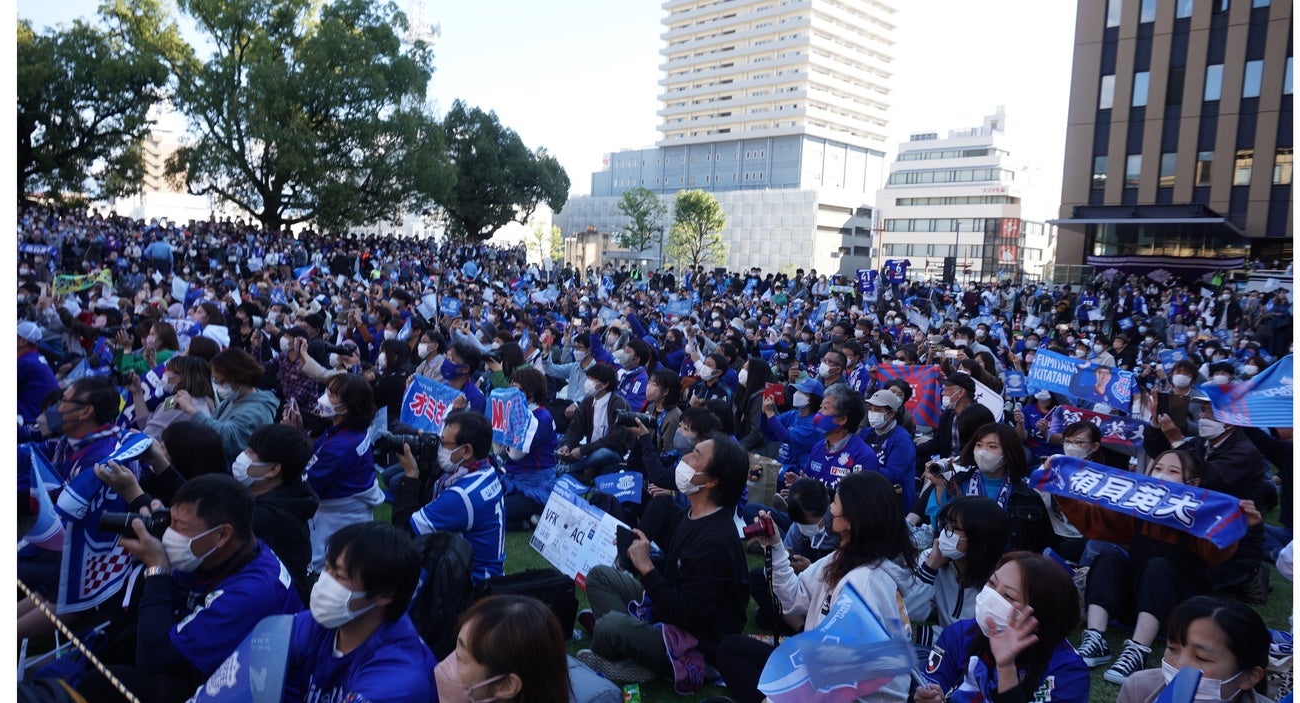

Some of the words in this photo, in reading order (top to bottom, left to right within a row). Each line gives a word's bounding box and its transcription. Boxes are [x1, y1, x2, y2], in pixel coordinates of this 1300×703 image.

[1036, 354, 1078, 374] FUMITAKA
[1033, 368, 1071, 387] KITATANI
[545, 508, 560, 527] VFK
[570, 527, 586, 546] ACL
